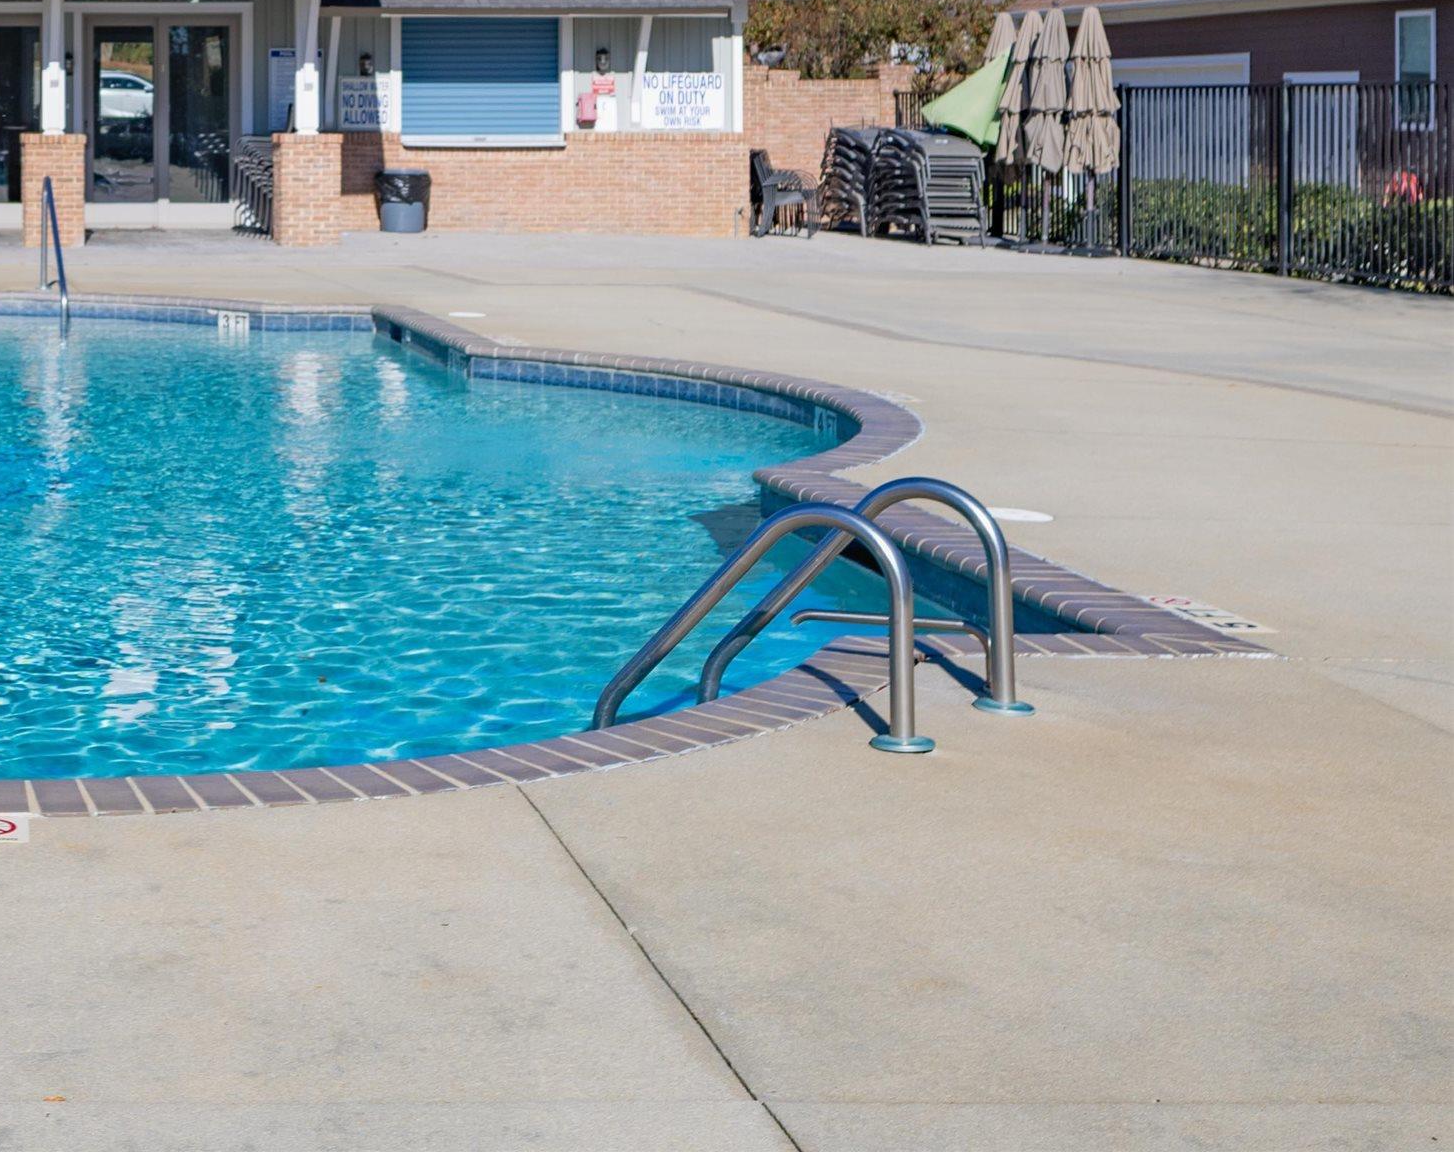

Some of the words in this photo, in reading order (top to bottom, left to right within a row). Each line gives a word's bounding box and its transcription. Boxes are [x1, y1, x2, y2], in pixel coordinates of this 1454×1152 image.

[643, 75, 659, 89] NO
[662, 75, 722, 89] LIFEGUARD
[343, 94, 355, 108] NO
[358, 94, 389, 108] DIVING
[659, 91, 674, 104] ON
[677, 91, 706, 104] DUTY
[343, 110, 388, 124] ALLOWED
[655, 107, 676, 115] SWIM
[679, 107, 687, 115] AT
[690, 107, 711, 115] YOUR
